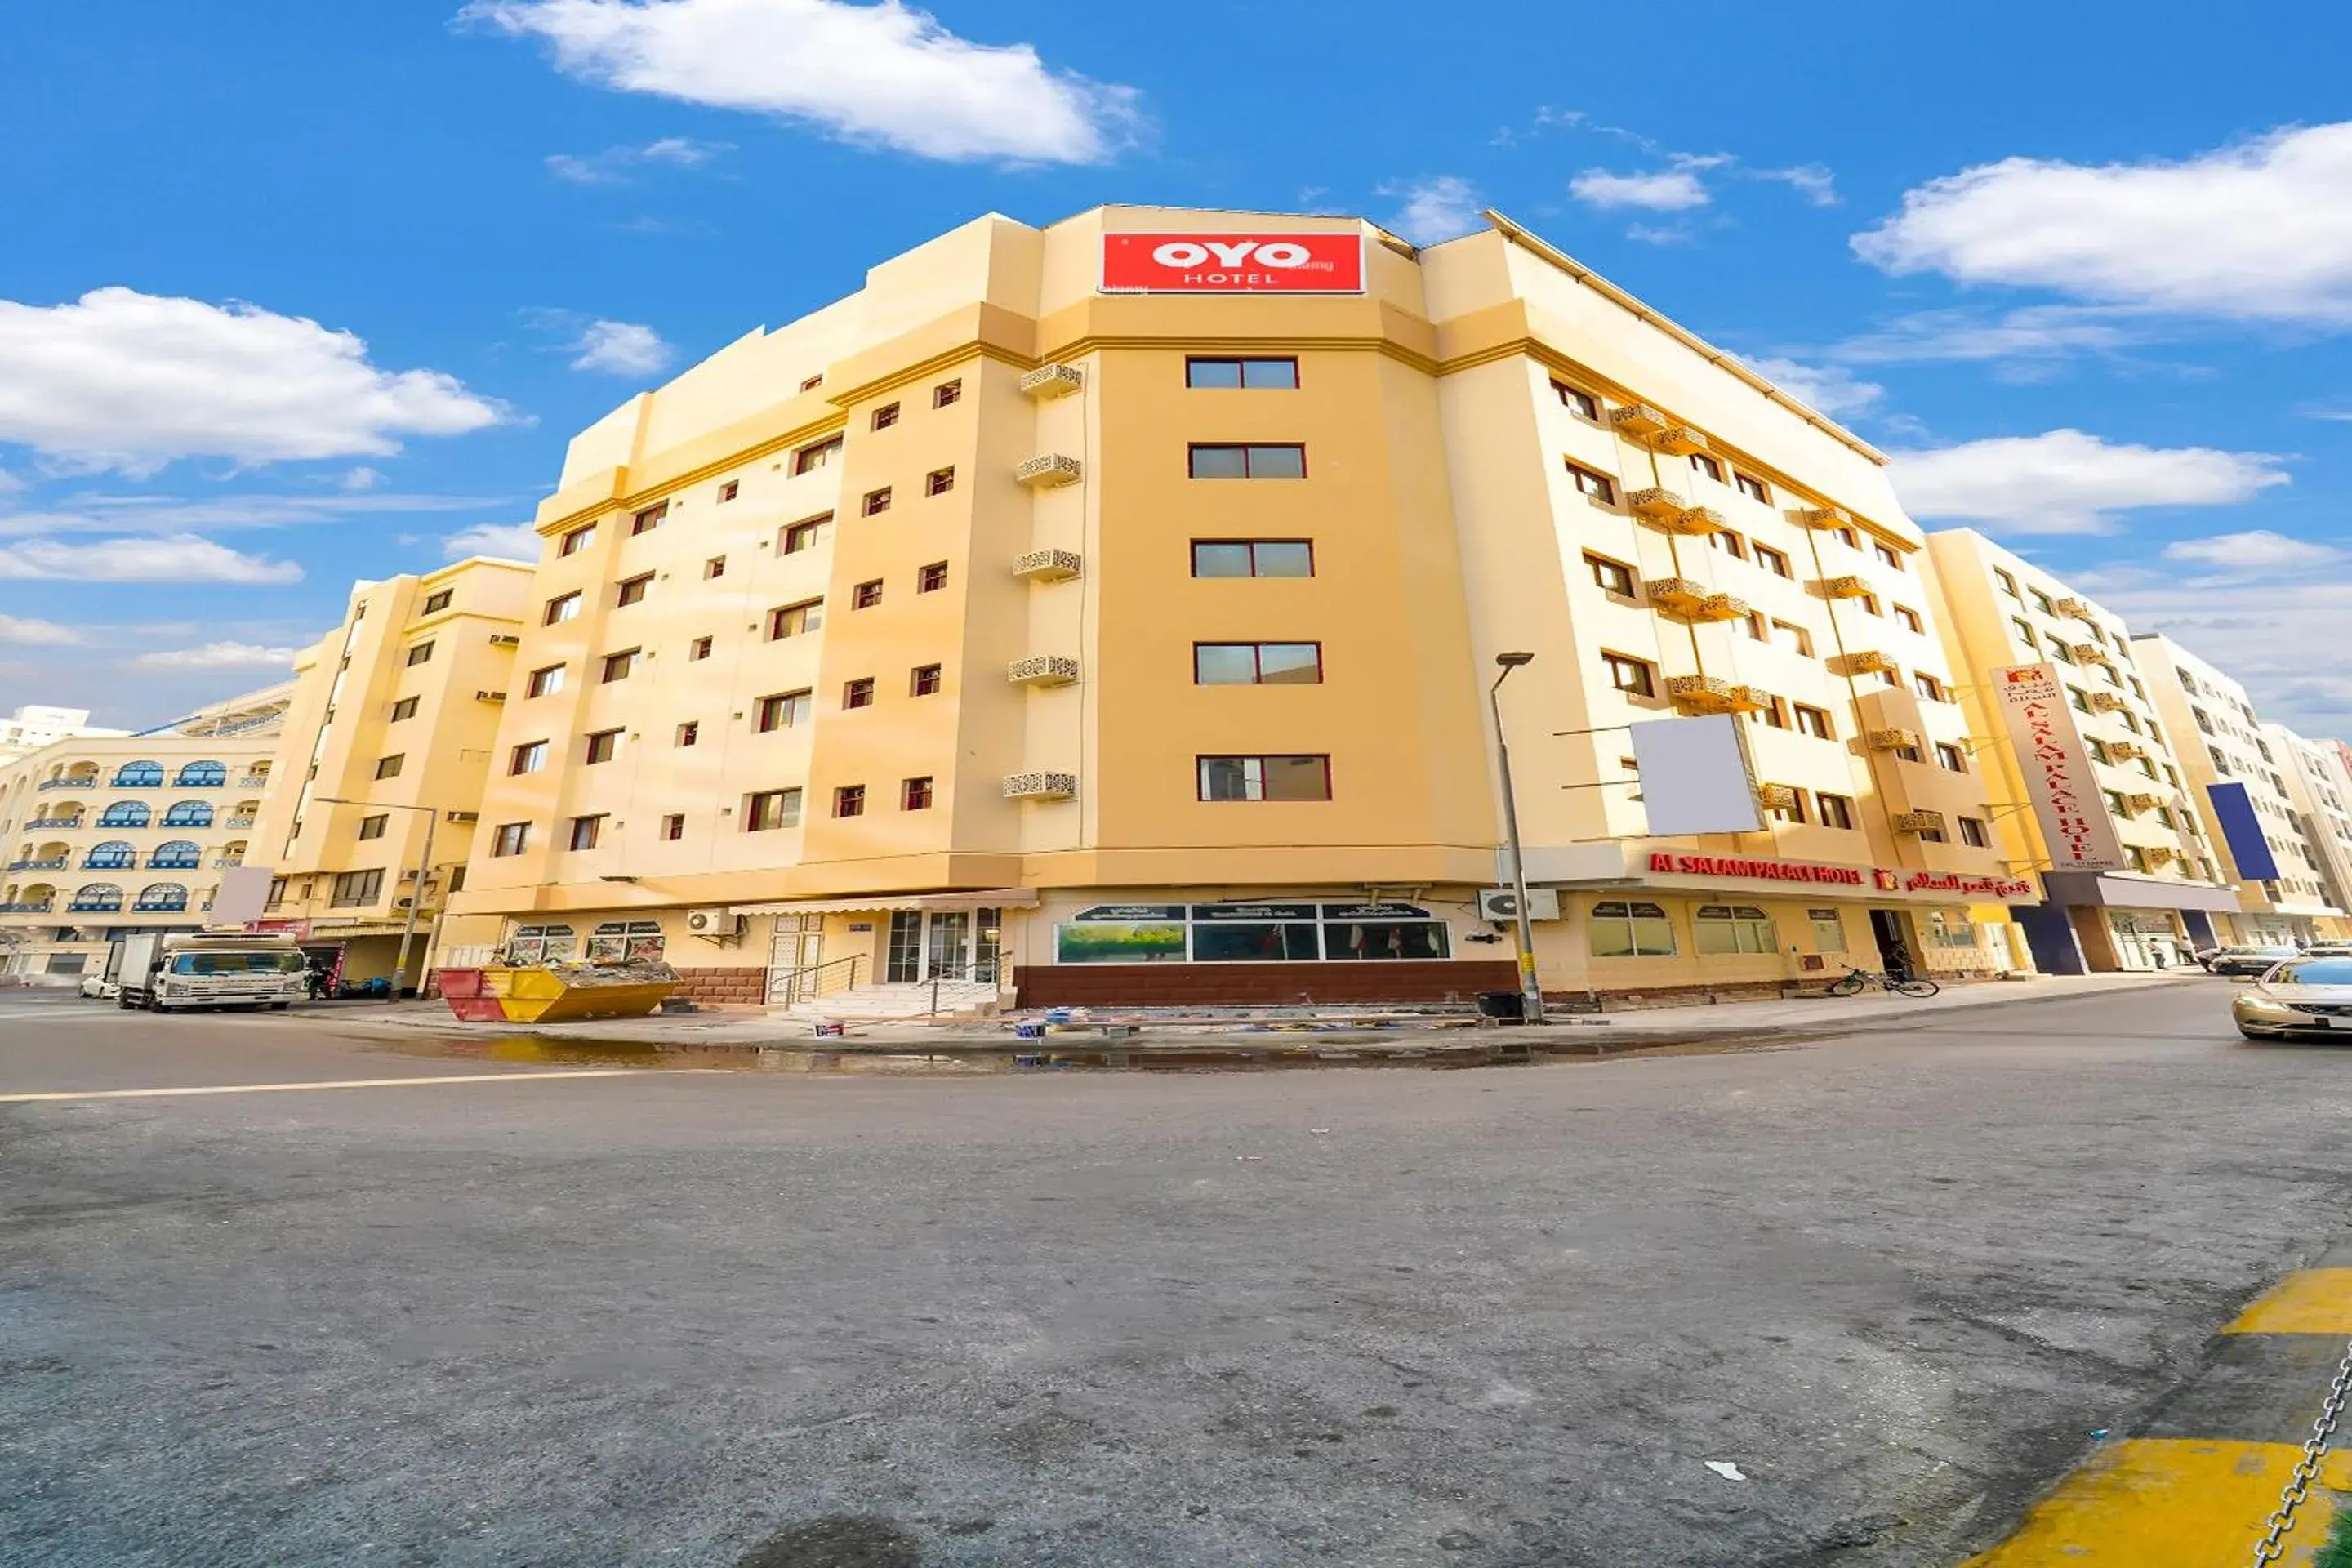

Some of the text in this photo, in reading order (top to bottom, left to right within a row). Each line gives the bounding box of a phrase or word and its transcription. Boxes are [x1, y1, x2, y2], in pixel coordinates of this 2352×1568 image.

[1152, 243, 1312, 268] OYO
[1184, 274, 1279, 284] HOTEL
[1650, 853, 1865, 884] AL SALAM PALACE HOTEL
